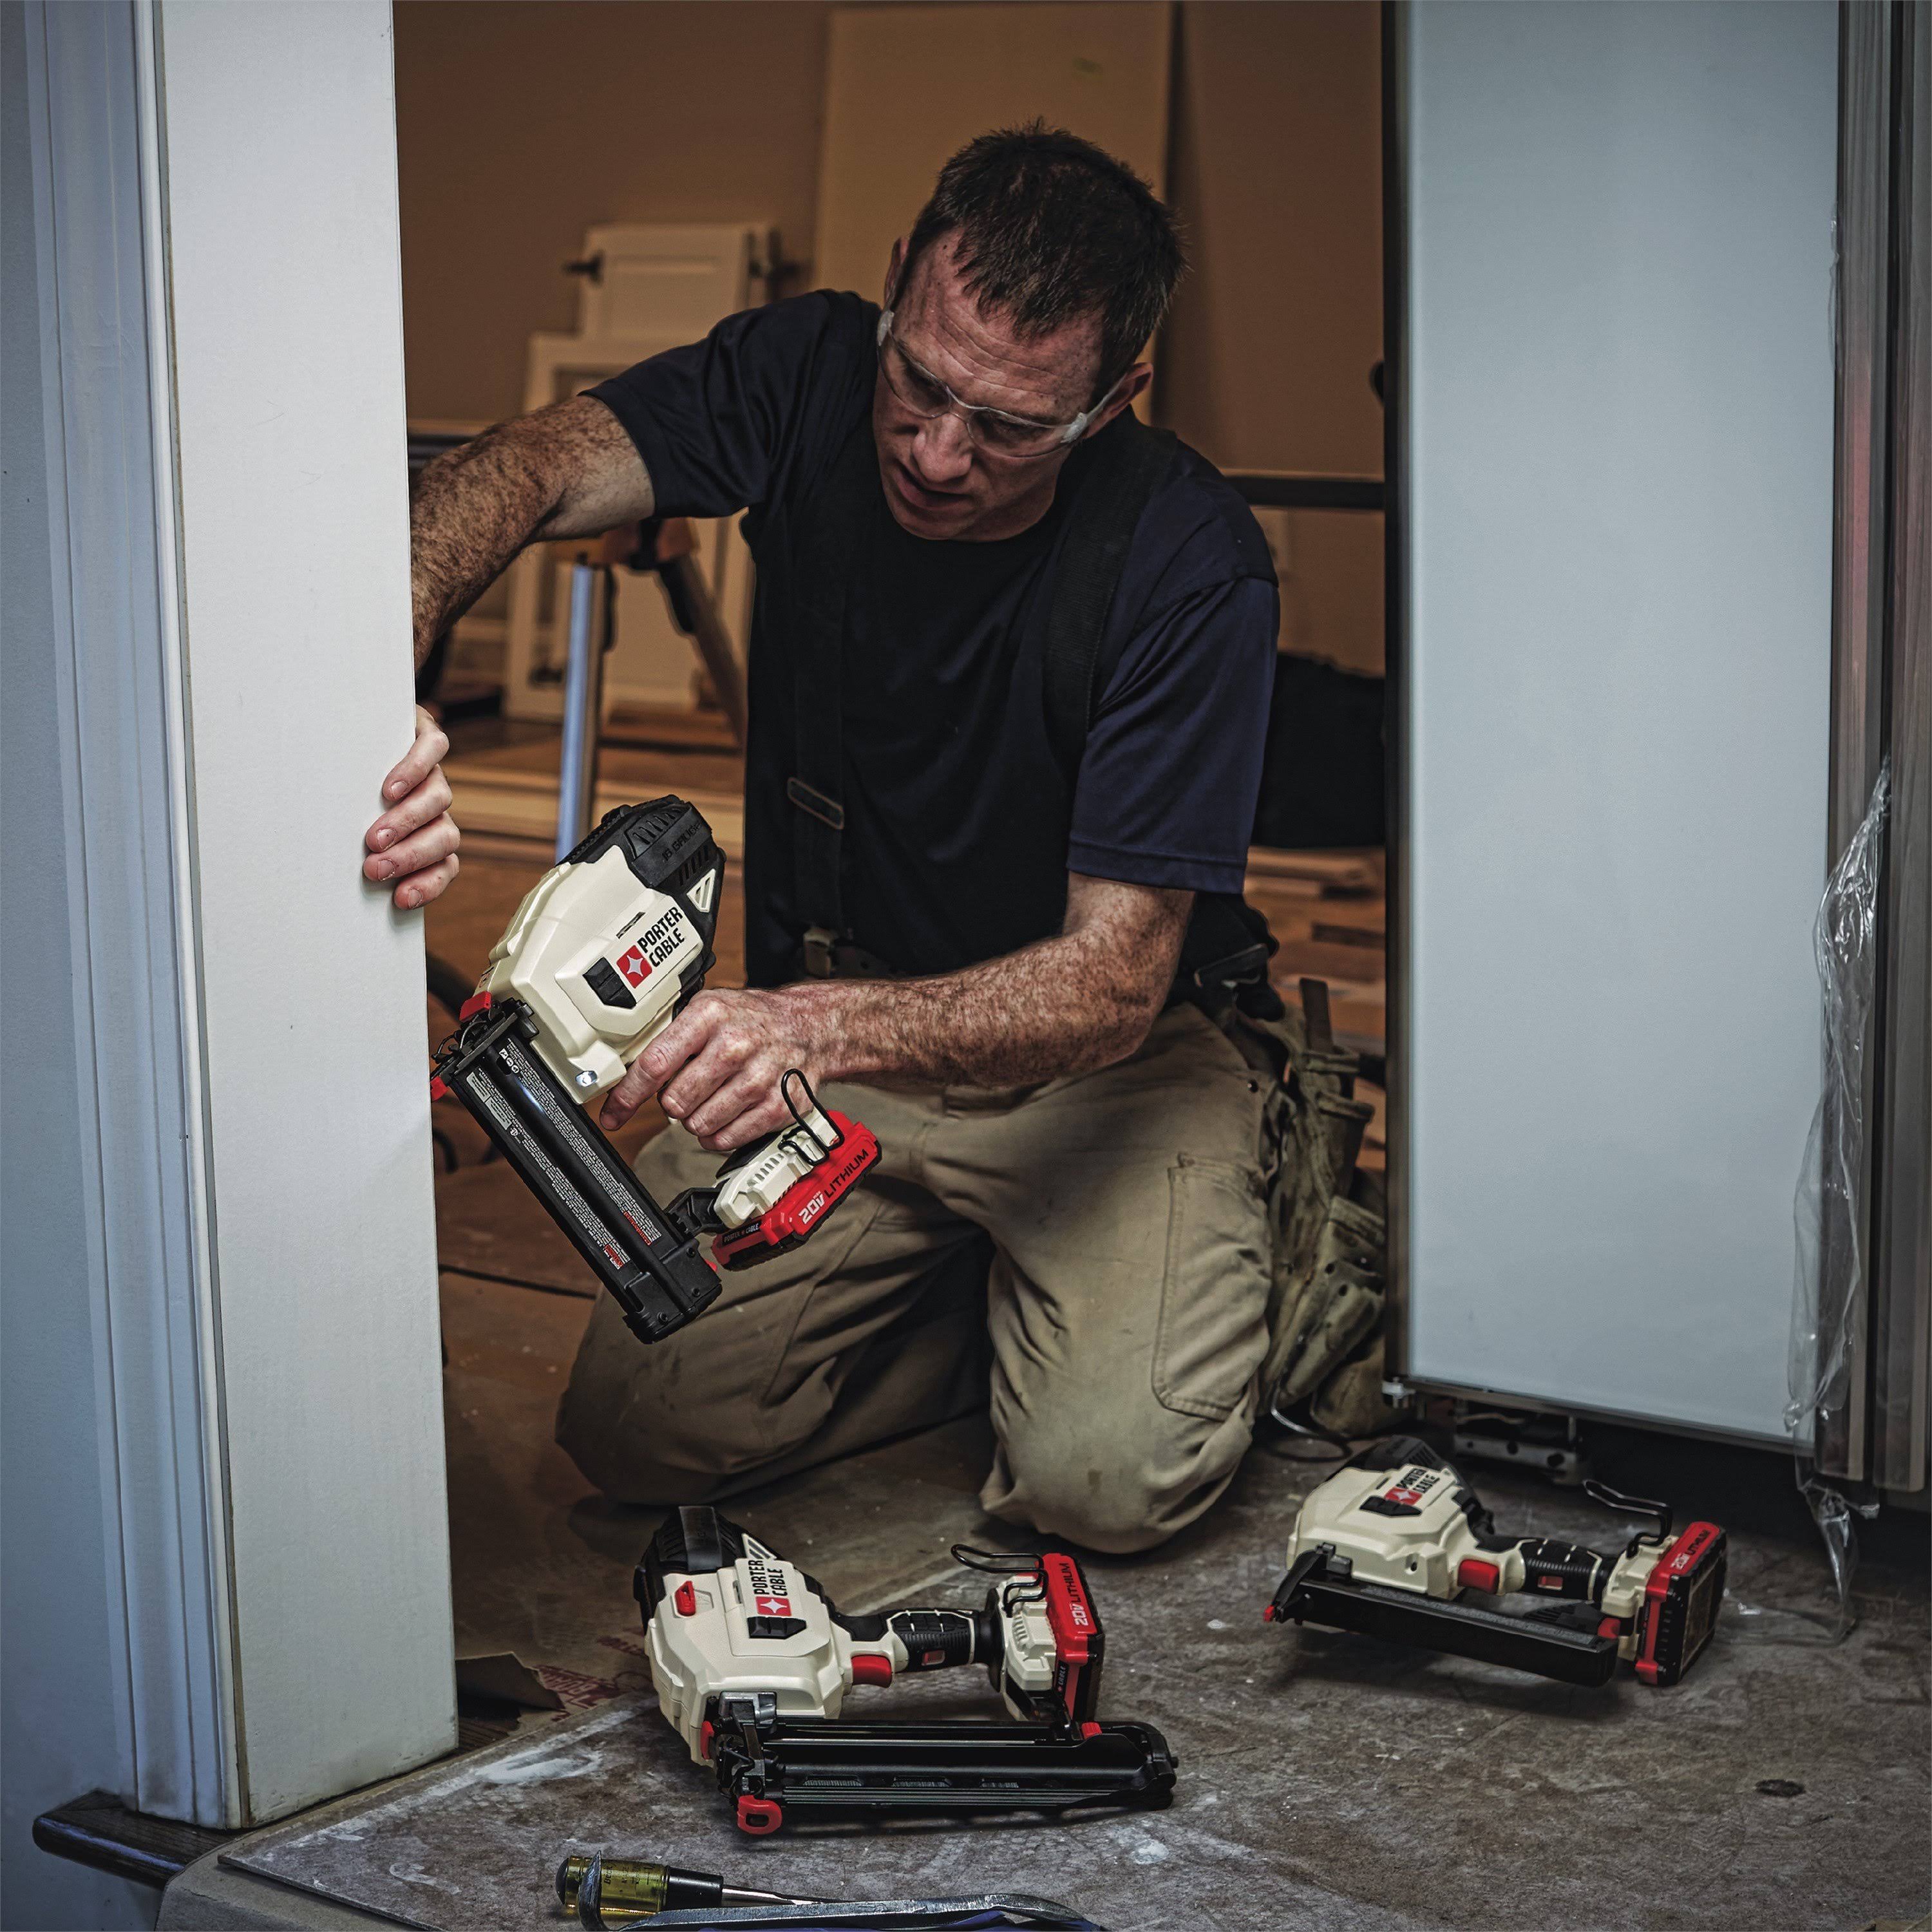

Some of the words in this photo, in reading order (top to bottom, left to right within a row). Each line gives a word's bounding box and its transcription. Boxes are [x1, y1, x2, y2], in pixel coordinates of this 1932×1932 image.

[637, 907, 683, 954] PORTER
[649, 927, 685, 967] CABLE
[799, 1193, 824, 1224] 20V
[824, 1149, 869, 1198] LITHIUM
[746, 1223, 759, 1234] CABLE
[748, 1560, 770, 1595] PORTER
[767, 1568, 788, 1596] CABLE
[1059, 1563, 1081, 1602] LITHIUM
[1072, 1603, 1089, 1626] 20V
